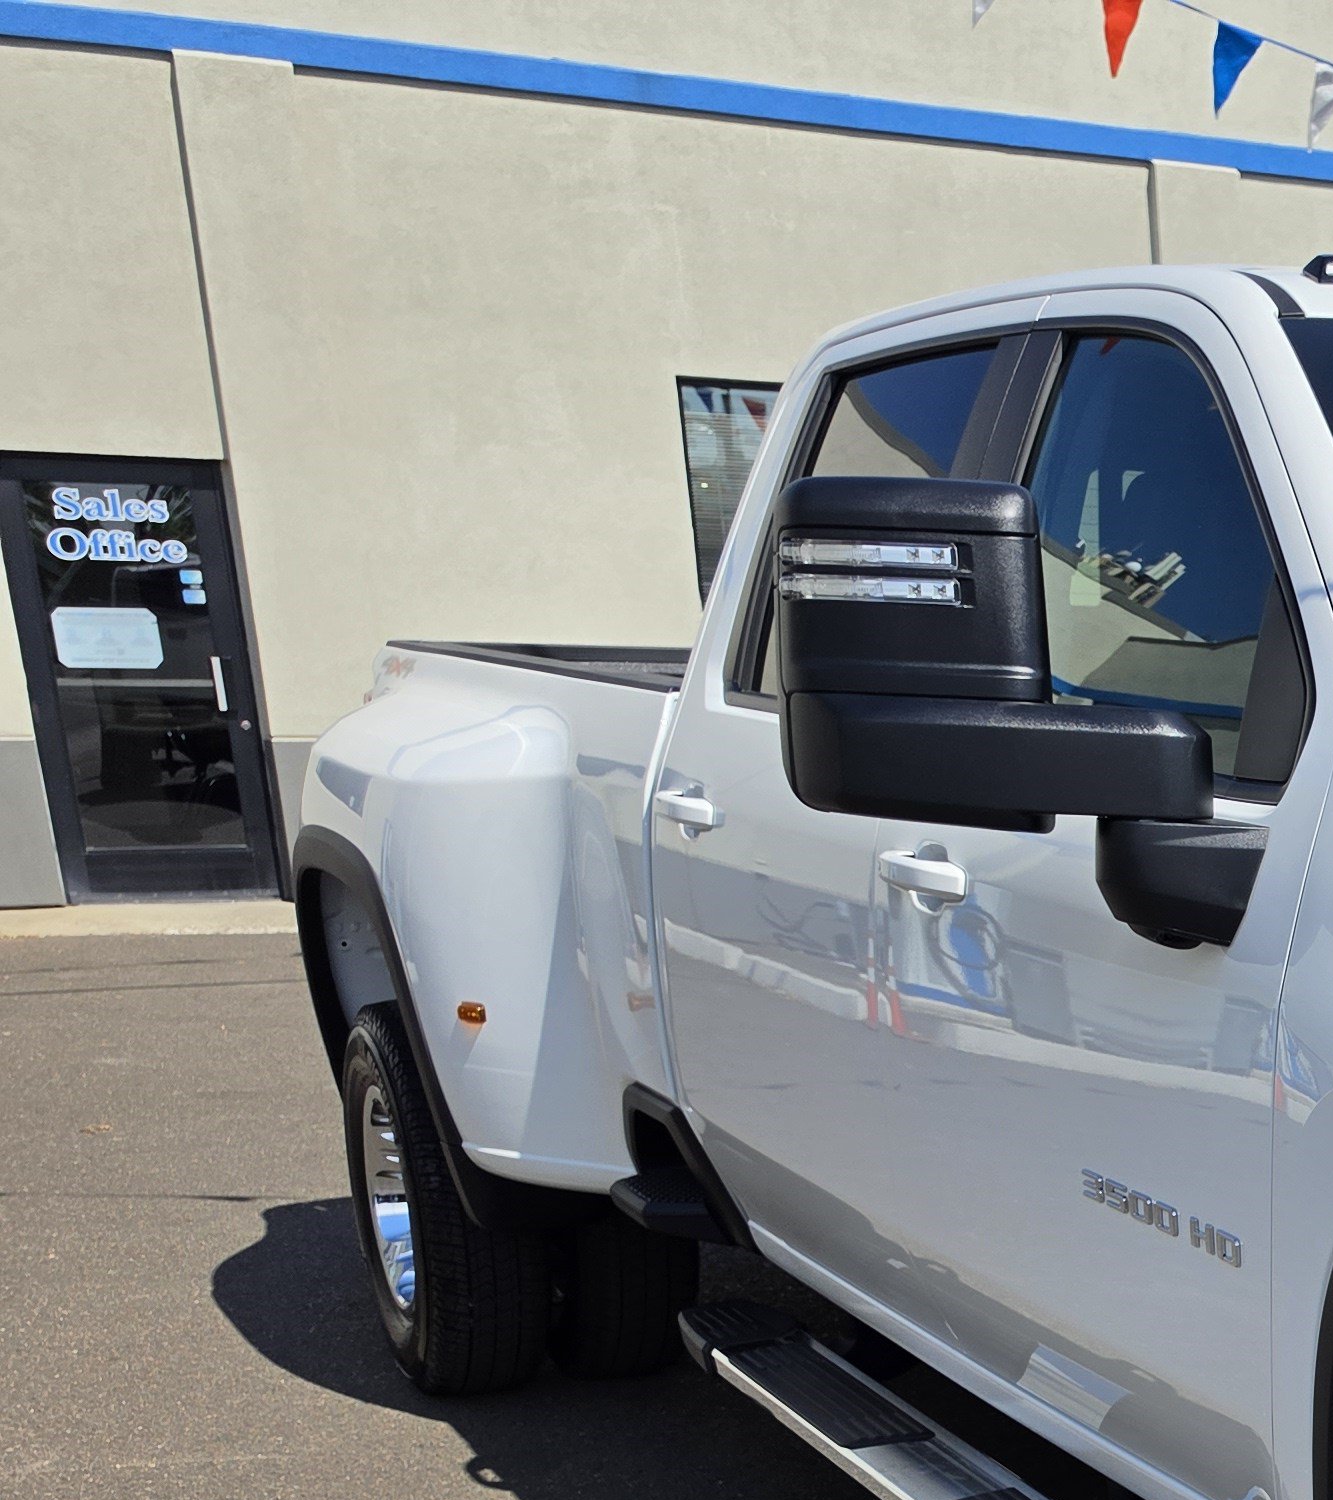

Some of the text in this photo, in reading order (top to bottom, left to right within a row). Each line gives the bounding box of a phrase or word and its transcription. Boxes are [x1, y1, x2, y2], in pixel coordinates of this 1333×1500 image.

[51, 486, 170, 524] Sales
[46, 526, 188, 564] Office
[1081, 1167, 1242, 1269] 3500 HD
